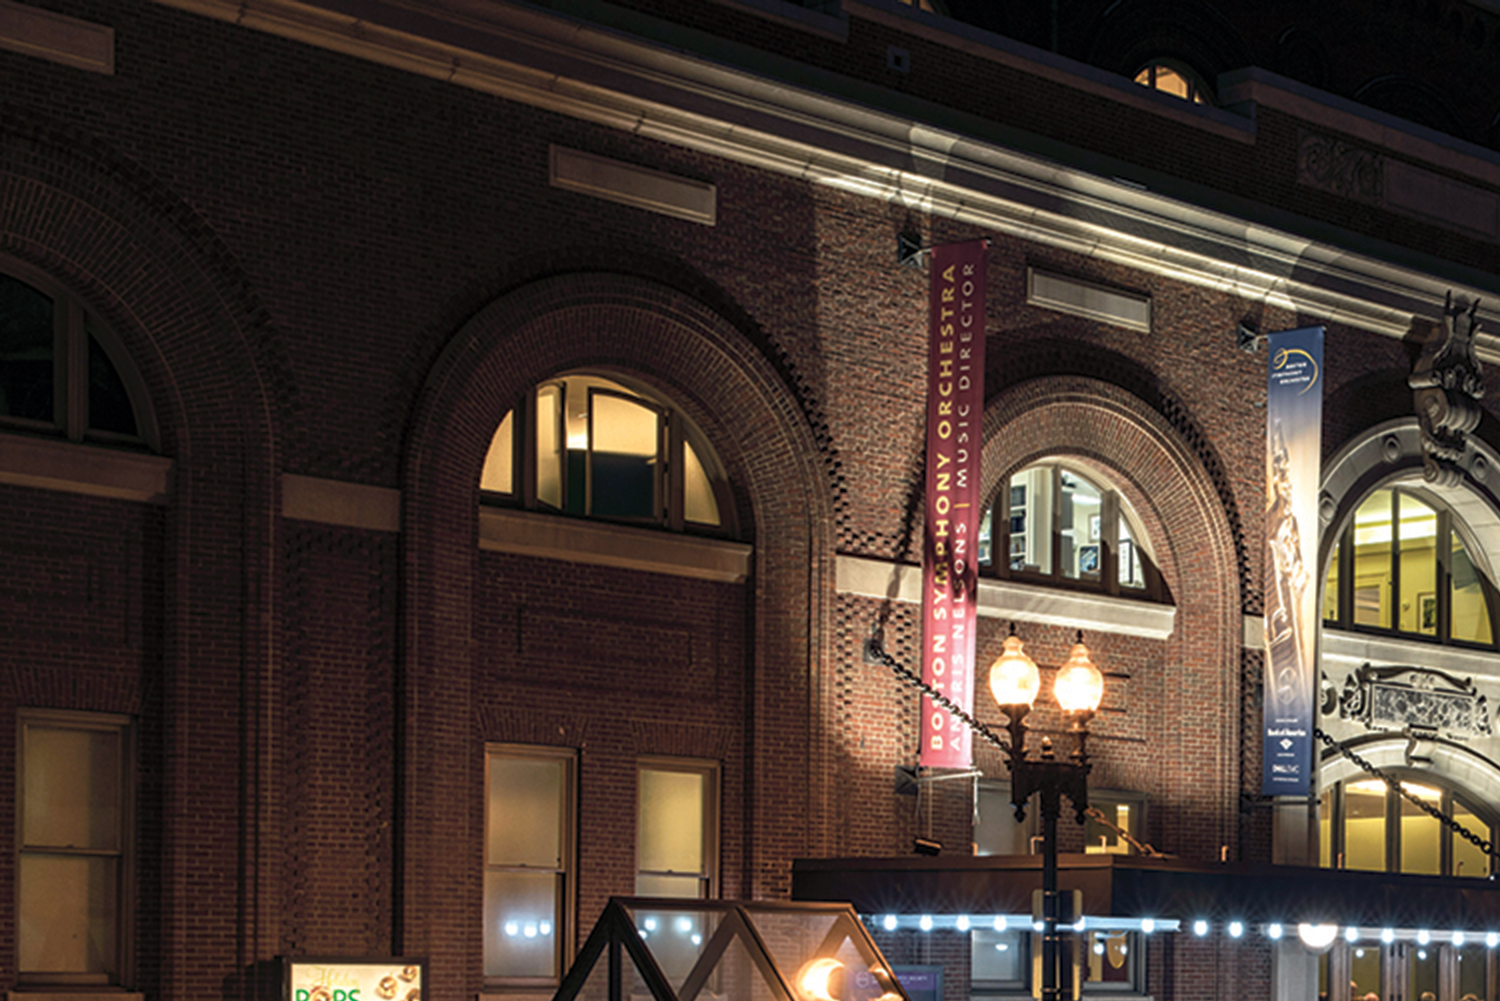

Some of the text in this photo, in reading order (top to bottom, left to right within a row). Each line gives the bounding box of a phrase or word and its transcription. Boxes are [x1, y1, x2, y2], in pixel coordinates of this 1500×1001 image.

[938, 264, 955, 440] ORCHESTRA
[958, 263, 975, 391] DIRECTOR
[957, 404, 970, 488] MUSIC
[933, 453, 950, 620] SYMPHONY
[952, 522, 967, 640] NELSONS
